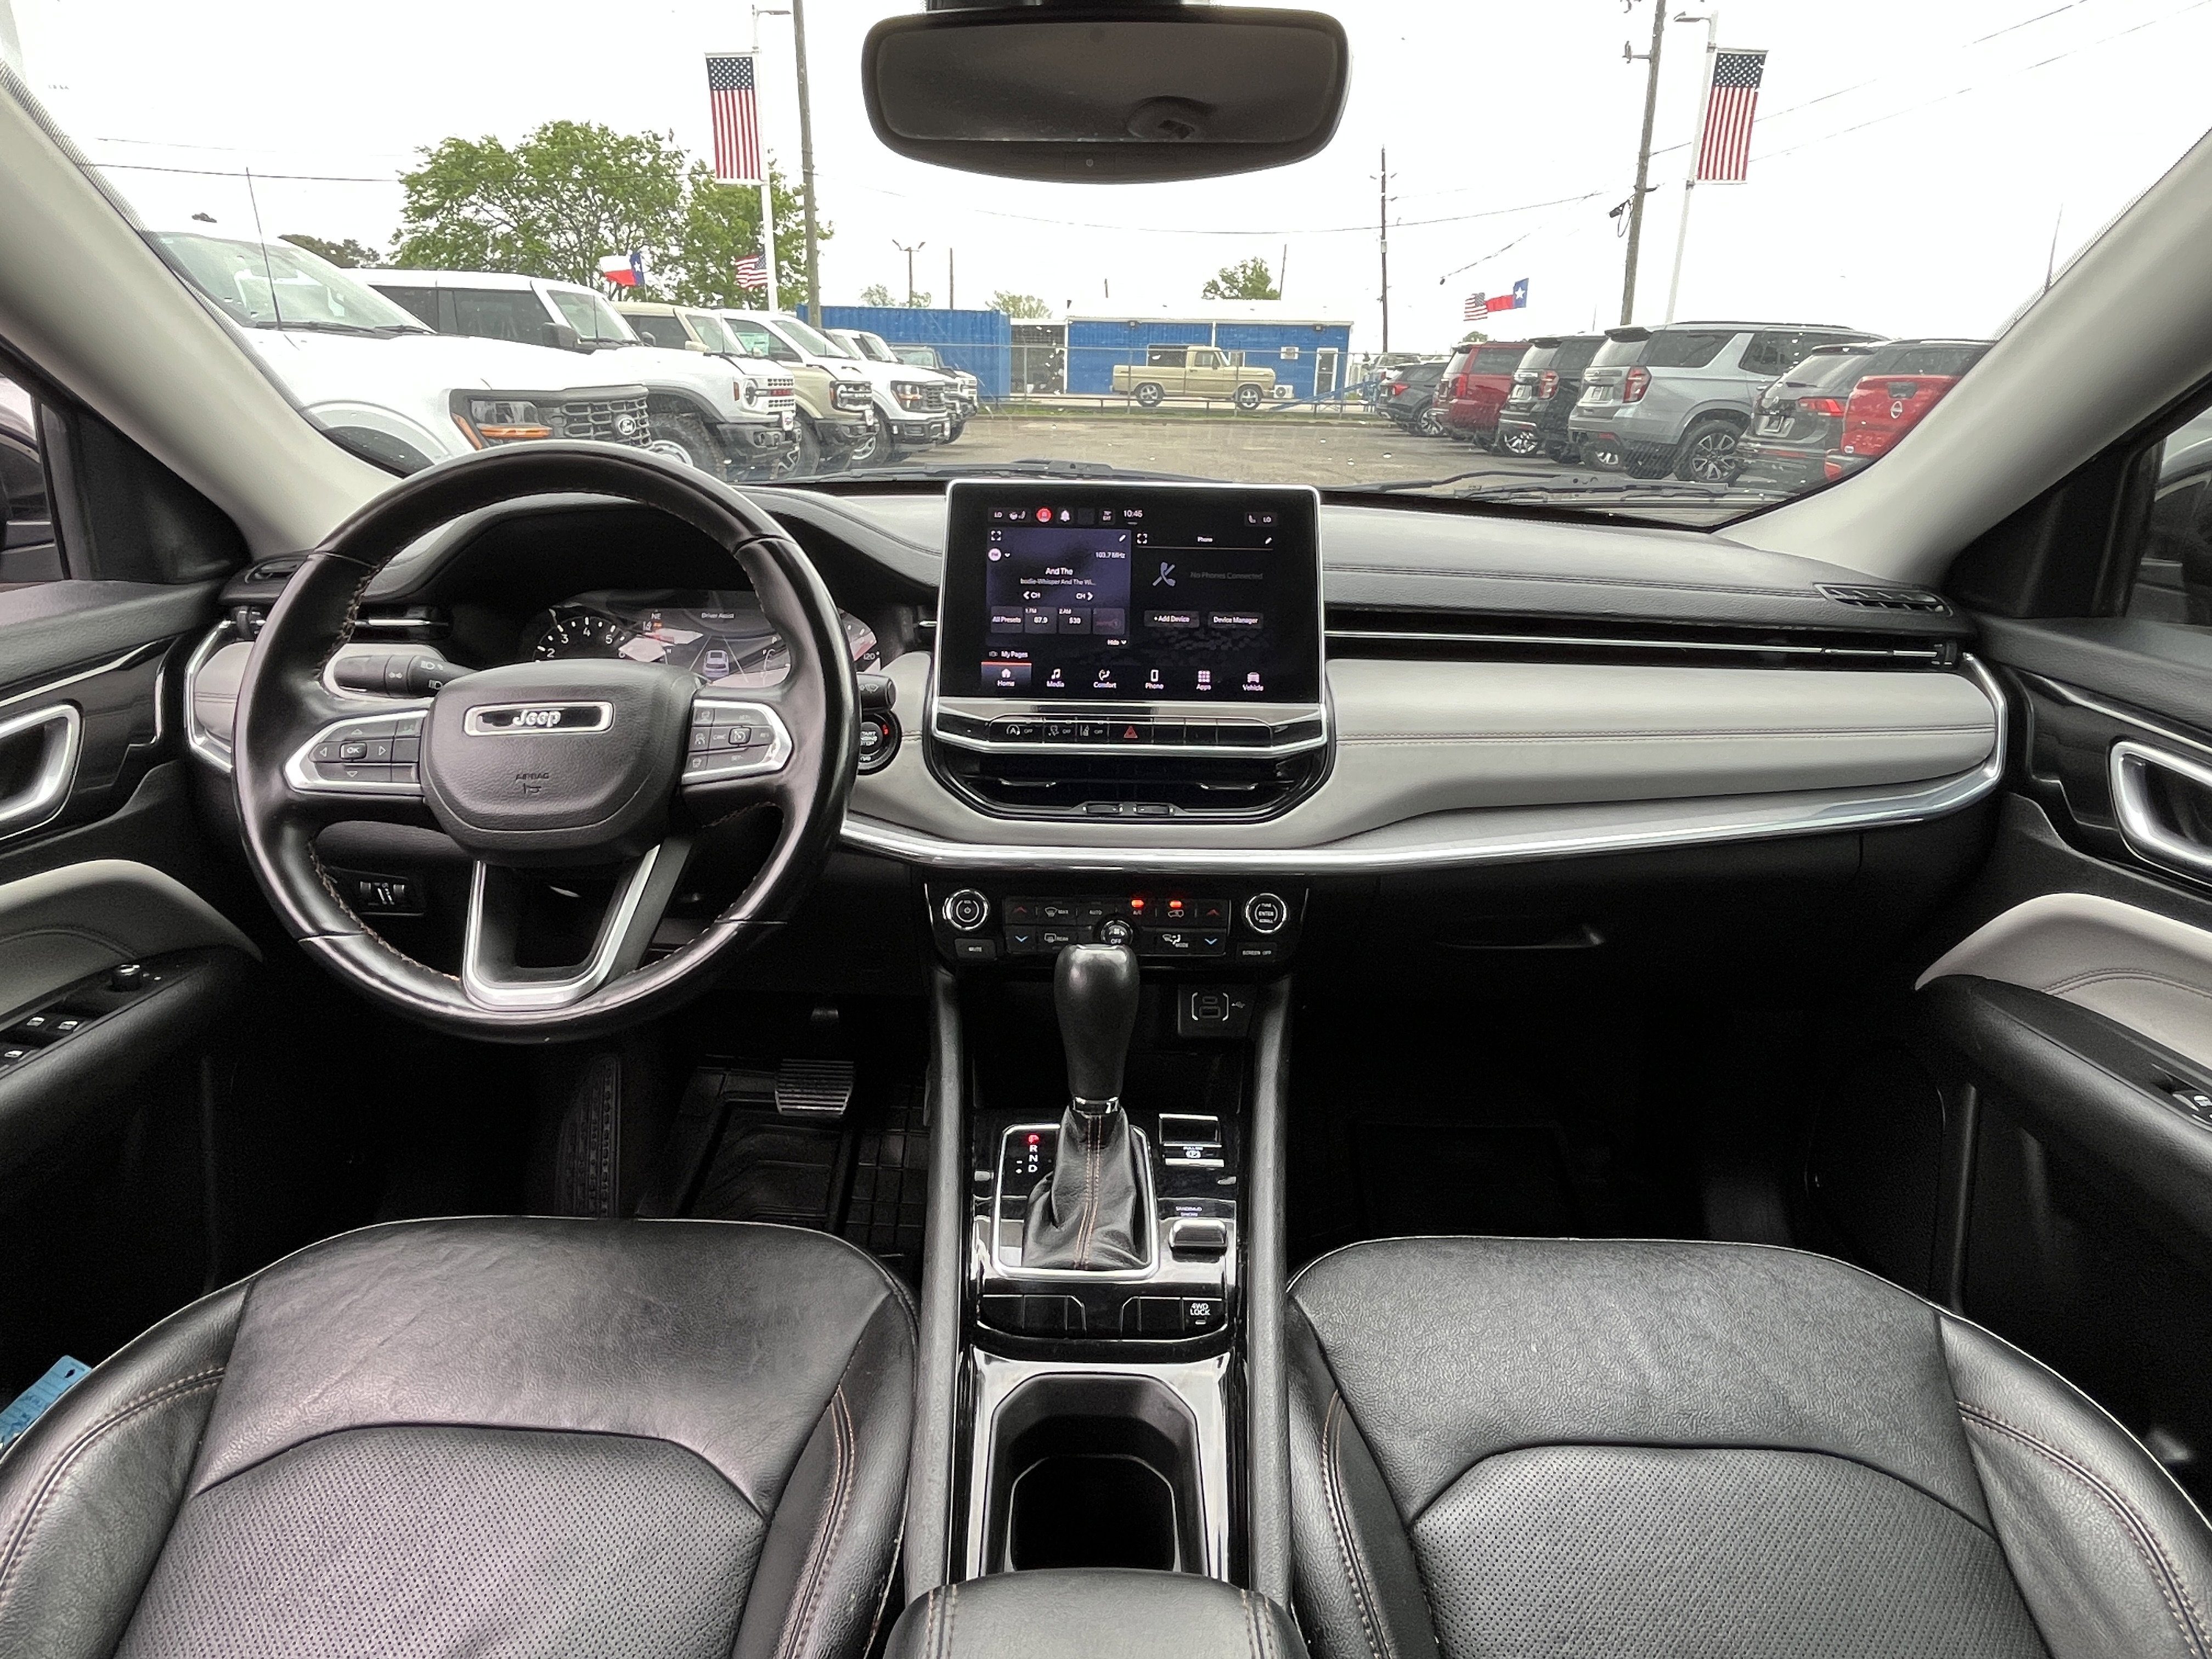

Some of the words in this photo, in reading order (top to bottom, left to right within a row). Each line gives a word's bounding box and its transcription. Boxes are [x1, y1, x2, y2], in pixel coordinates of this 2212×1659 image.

[1060, 567, 1073, 575] The
[583, 627, 591, 637] 4
[561, 634, 569, 644] 3
[605, 634, 613, 644] 5
[546, 648, 556, 658] 2
[864, 652, 876, 661] 120
[512, 709, 562, 727] Jeep
[346, 746, 360, 754] OK
[1028, 1164, 1038, 1172] D
